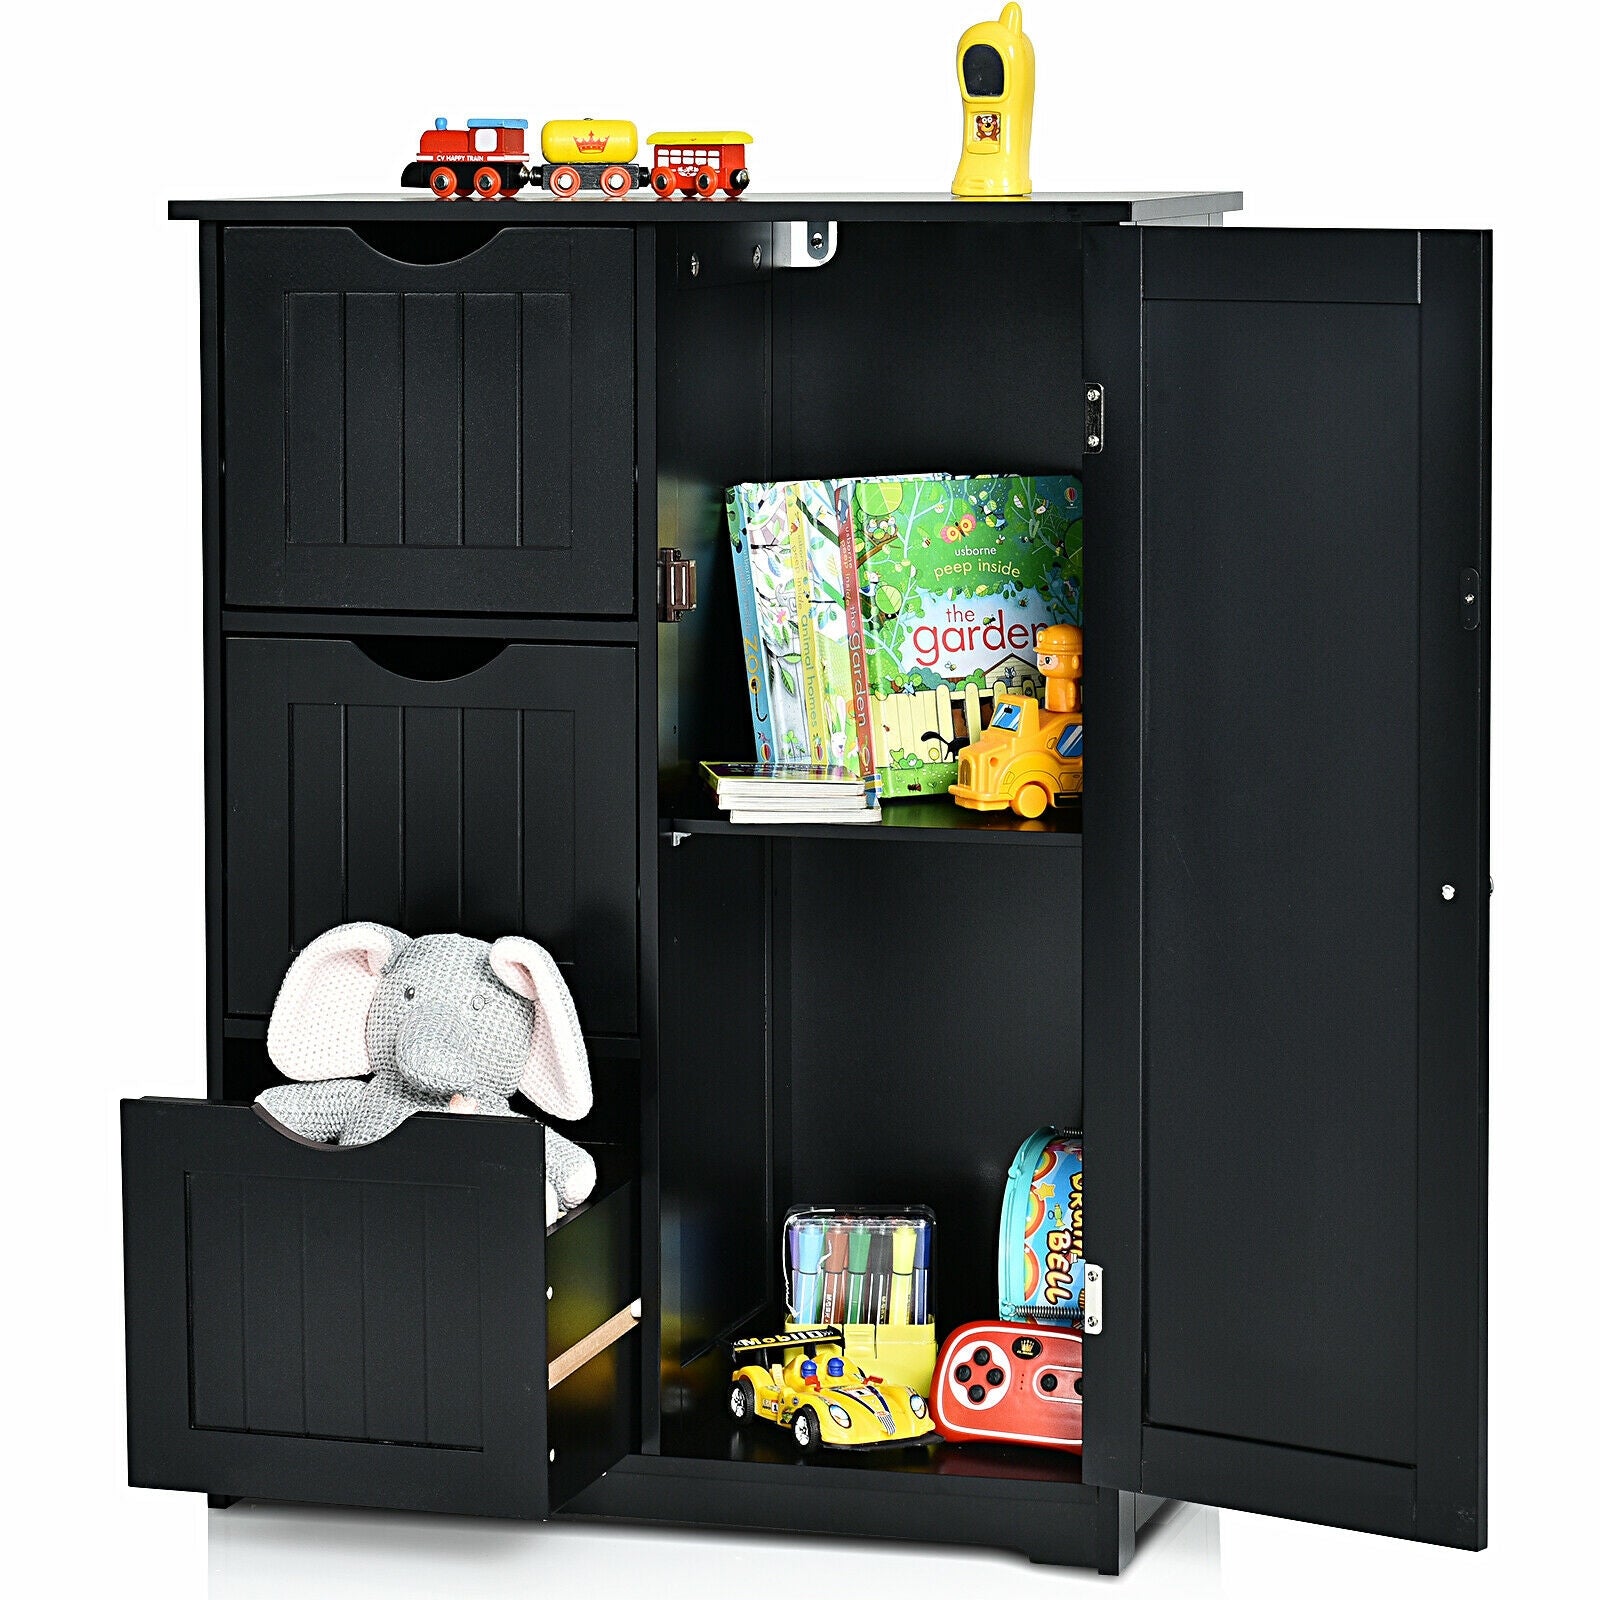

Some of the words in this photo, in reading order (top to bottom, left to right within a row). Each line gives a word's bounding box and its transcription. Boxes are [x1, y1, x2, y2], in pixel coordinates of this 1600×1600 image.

[840, 540, 850, 569] peep
[845, 526, 853, 569] usborne
[954, 545, 997, 556] usborne
[934, 561, 973, 581] peep
[978, 558, 1020, 578] inside
[849, 606, 858, 628] the
[946, 604, 975, 623] the
[801, 615, 815, 670] animal
[849, 632, 867, 727] garden
[807, 675, 817, 727] homes
[1045, 1228, 1074, 1306] BELL
